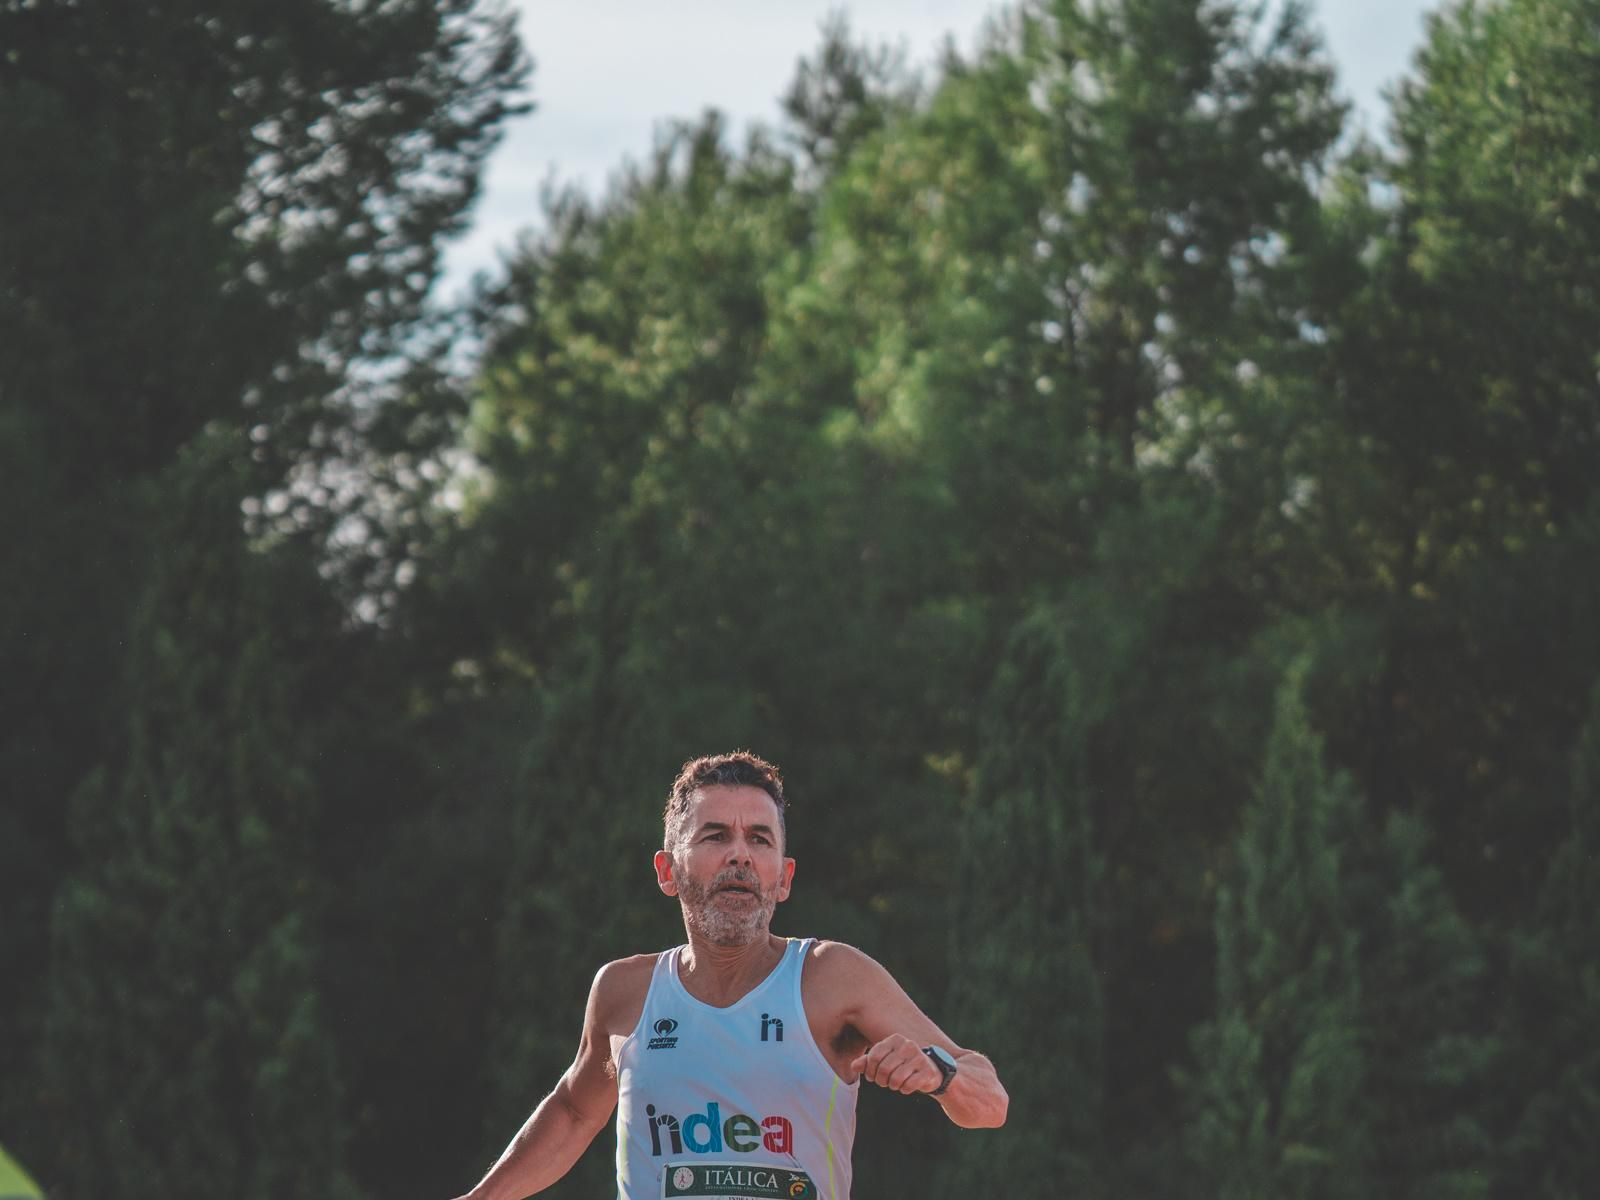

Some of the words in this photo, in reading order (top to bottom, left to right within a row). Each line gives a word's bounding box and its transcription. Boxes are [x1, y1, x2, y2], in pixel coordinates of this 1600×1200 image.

[760, 1012, 784, 1042] in
[645, 1102, 793, 1157] indea
[705, 1166, 779, 1189] ITÁLICA
